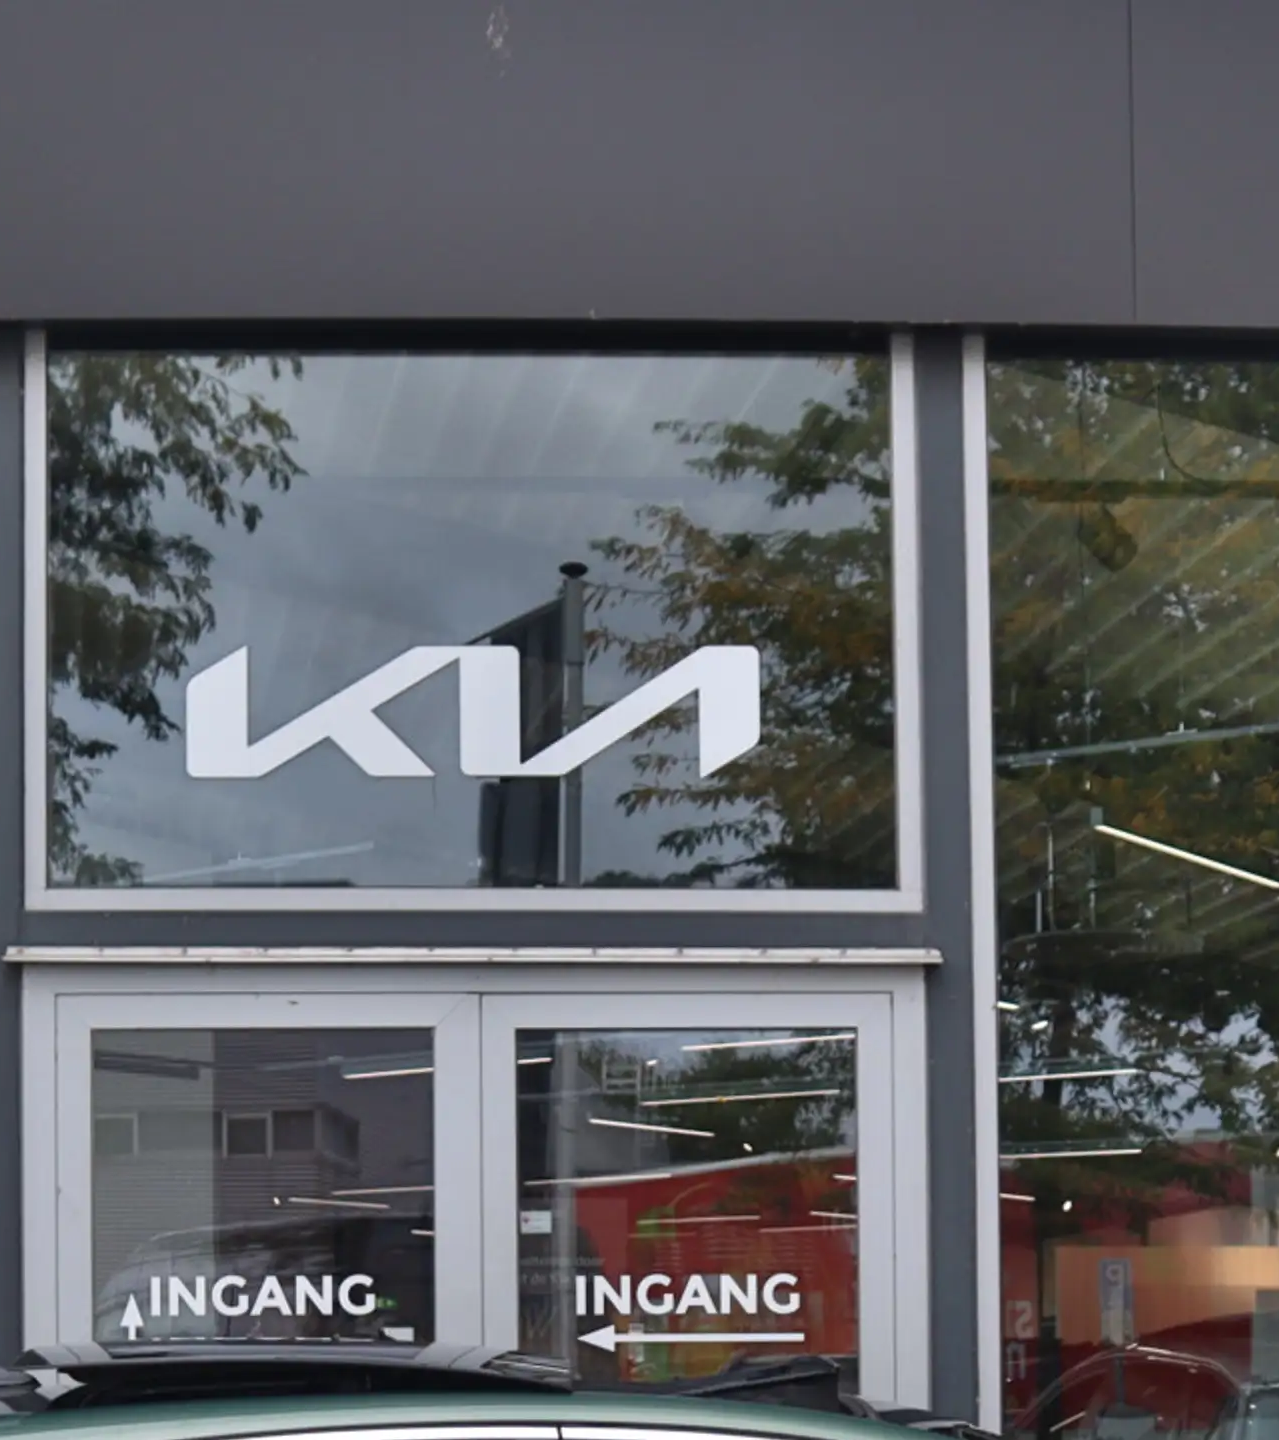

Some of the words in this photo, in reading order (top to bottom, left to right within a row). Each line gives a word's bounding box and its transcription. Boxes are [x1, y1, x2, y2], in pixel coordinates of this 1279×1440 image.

[185, 644, 761, 778] KIA
[150, 1273, 376, 1317] INGANG
[575, 1272, 801, 1316] INGANG
